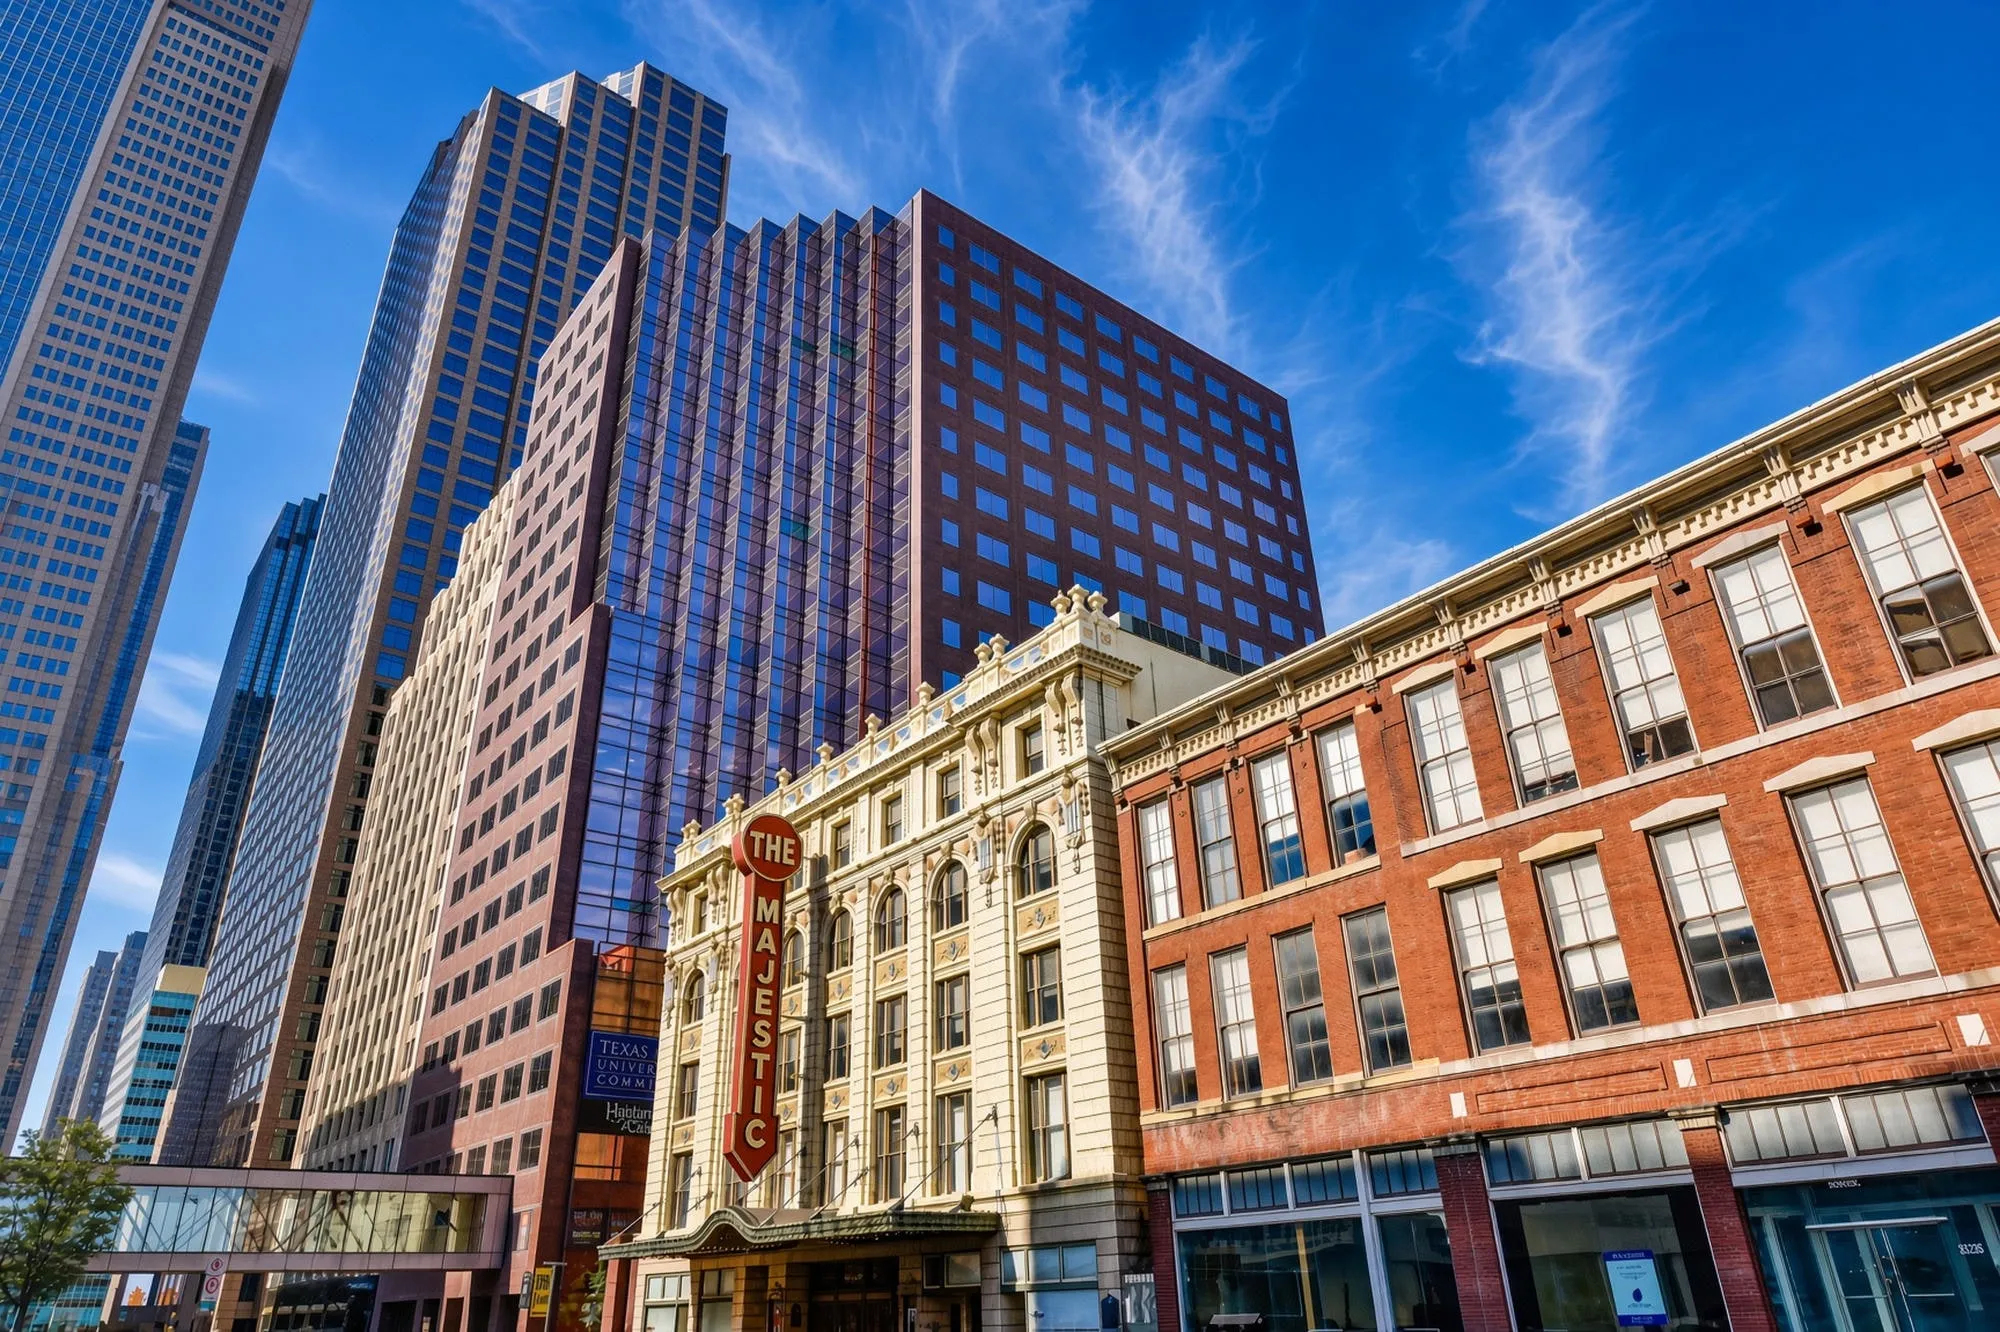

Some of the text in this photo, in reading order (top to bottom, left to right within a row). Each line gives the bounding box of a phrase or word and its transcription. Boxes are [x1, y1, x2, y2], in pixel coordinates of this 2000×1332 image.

[750, 830, 796, 866] THE
[744, 896, 780, 1149] MAJESTIC
[600, 1039, 649, 1060] TEXAS
